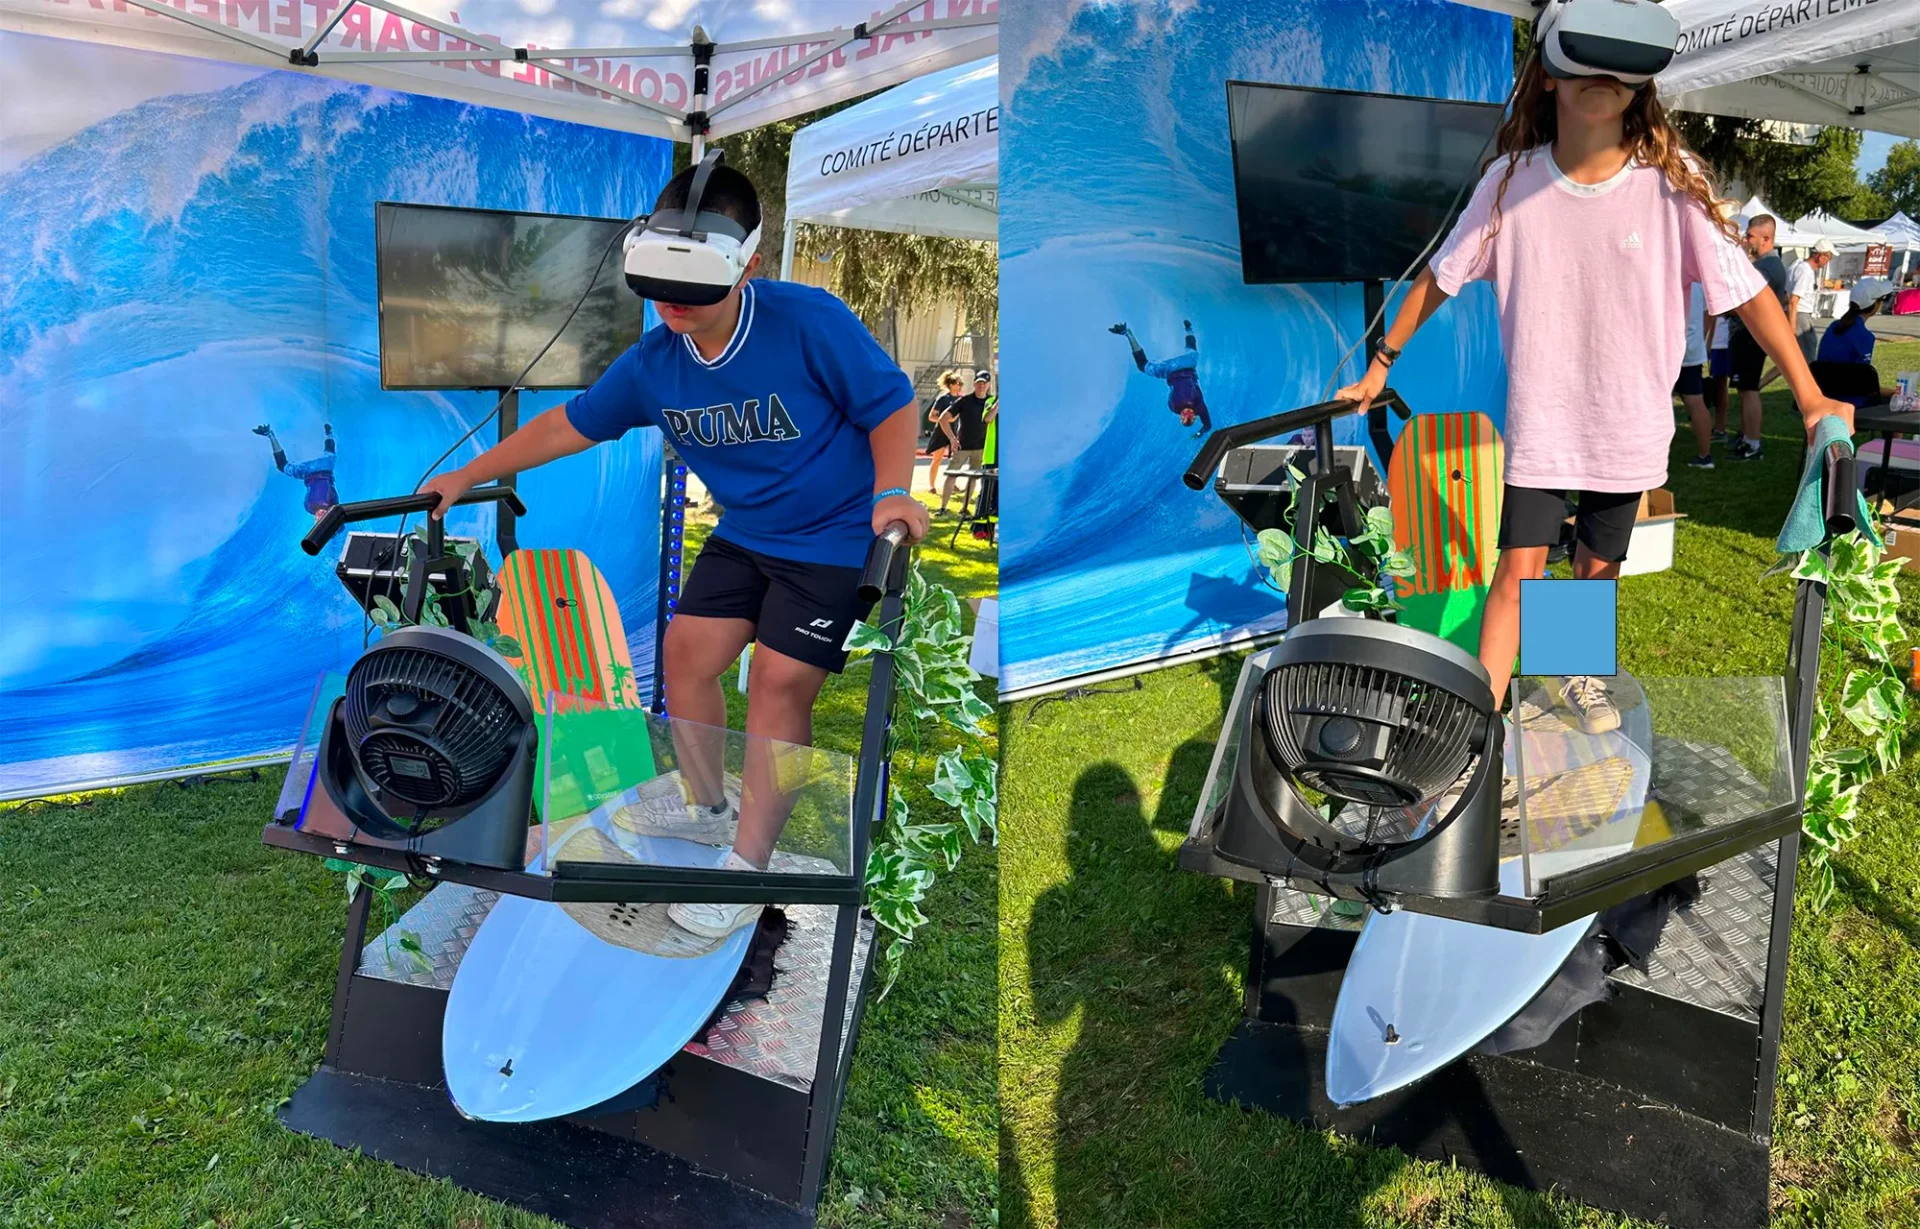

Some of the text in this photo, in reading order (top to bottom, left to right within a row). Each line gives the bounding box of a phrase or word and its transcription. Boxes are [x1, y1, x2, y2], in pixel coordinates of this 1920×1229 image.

[1674, 16, 1736, 55] OMITÉ
[821, 131, 892, 177] COMITÉ
[662, 393, 801, 447] PUMA
[794, 626, 833, 643] PRO TOUCH
